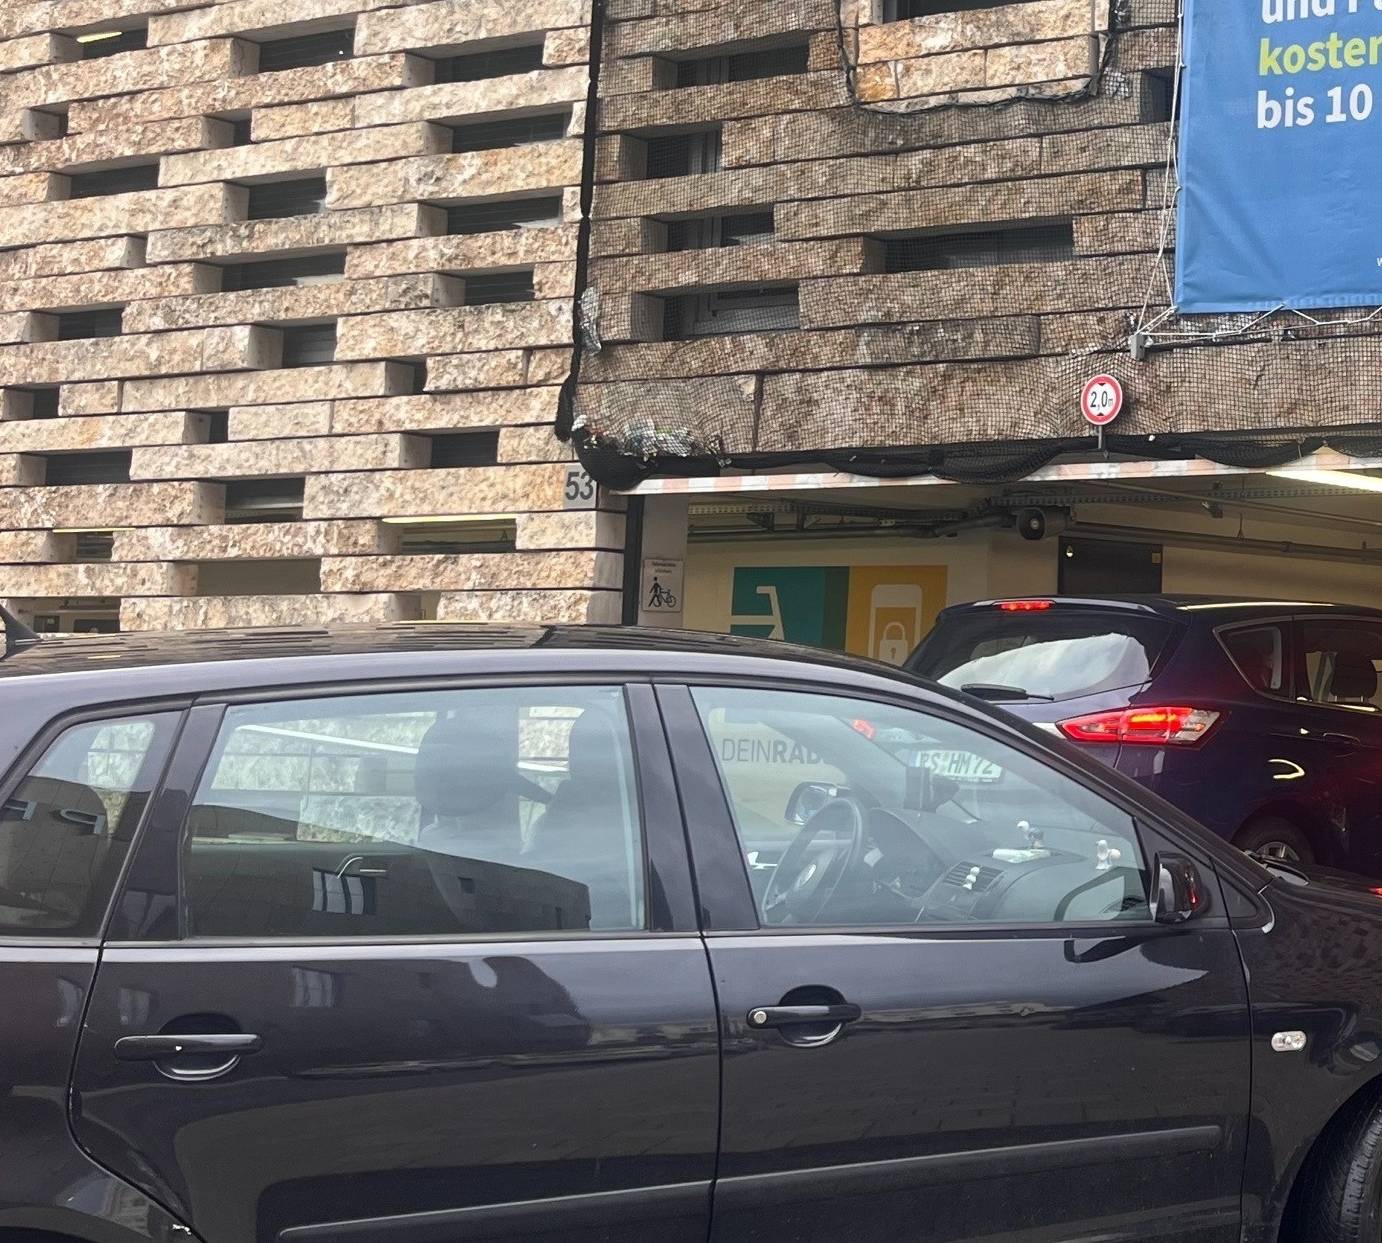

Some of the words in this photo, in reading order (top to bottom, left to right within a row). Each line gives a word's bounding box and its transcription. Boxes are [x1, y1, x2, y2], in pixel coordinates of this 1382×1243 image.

[1257, 87, 1315, 129] bis
[1325, 83, 1373, 123] 10
[565, 471, 594, 500] 53
